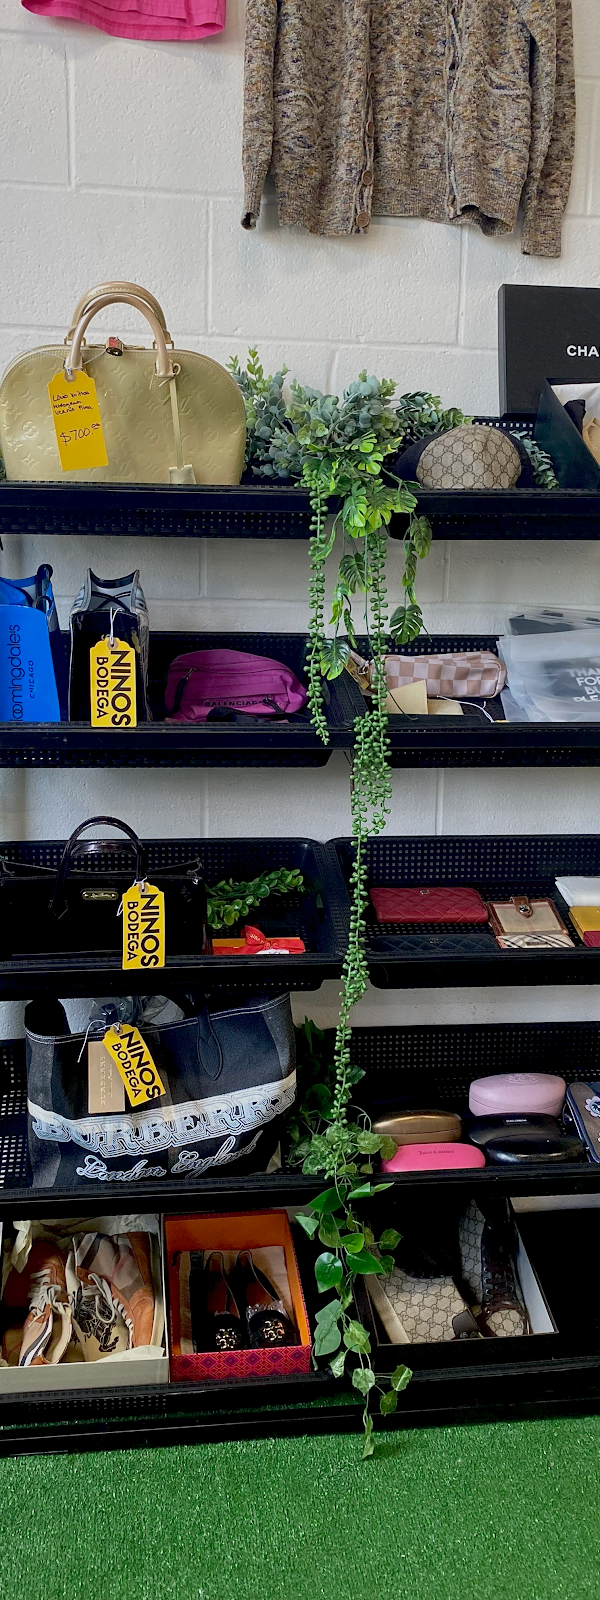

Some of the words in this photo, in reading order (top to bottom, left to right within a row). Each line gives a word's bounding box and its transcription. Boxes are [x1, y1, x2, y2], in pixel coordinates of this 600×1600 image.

[566, 345, 600, 357] CHA
[7, 624, 25, 722] loomingdale's
[28, 660, 36, 698] CHICAGO
[96, 656, 109, 719] BODEGA
[110, 650, 132, 726] NINOS
[127, 901, 139, 961] BODEGA
[140, 893, 160, 967] NINOS
[111, 1042, 142, 1099] BODEGA
[119, 1030, 161, 1099] NINOS
[31, 1082, 296, 1158] BURBERRY
[171, 1135, 263, 1180] England
